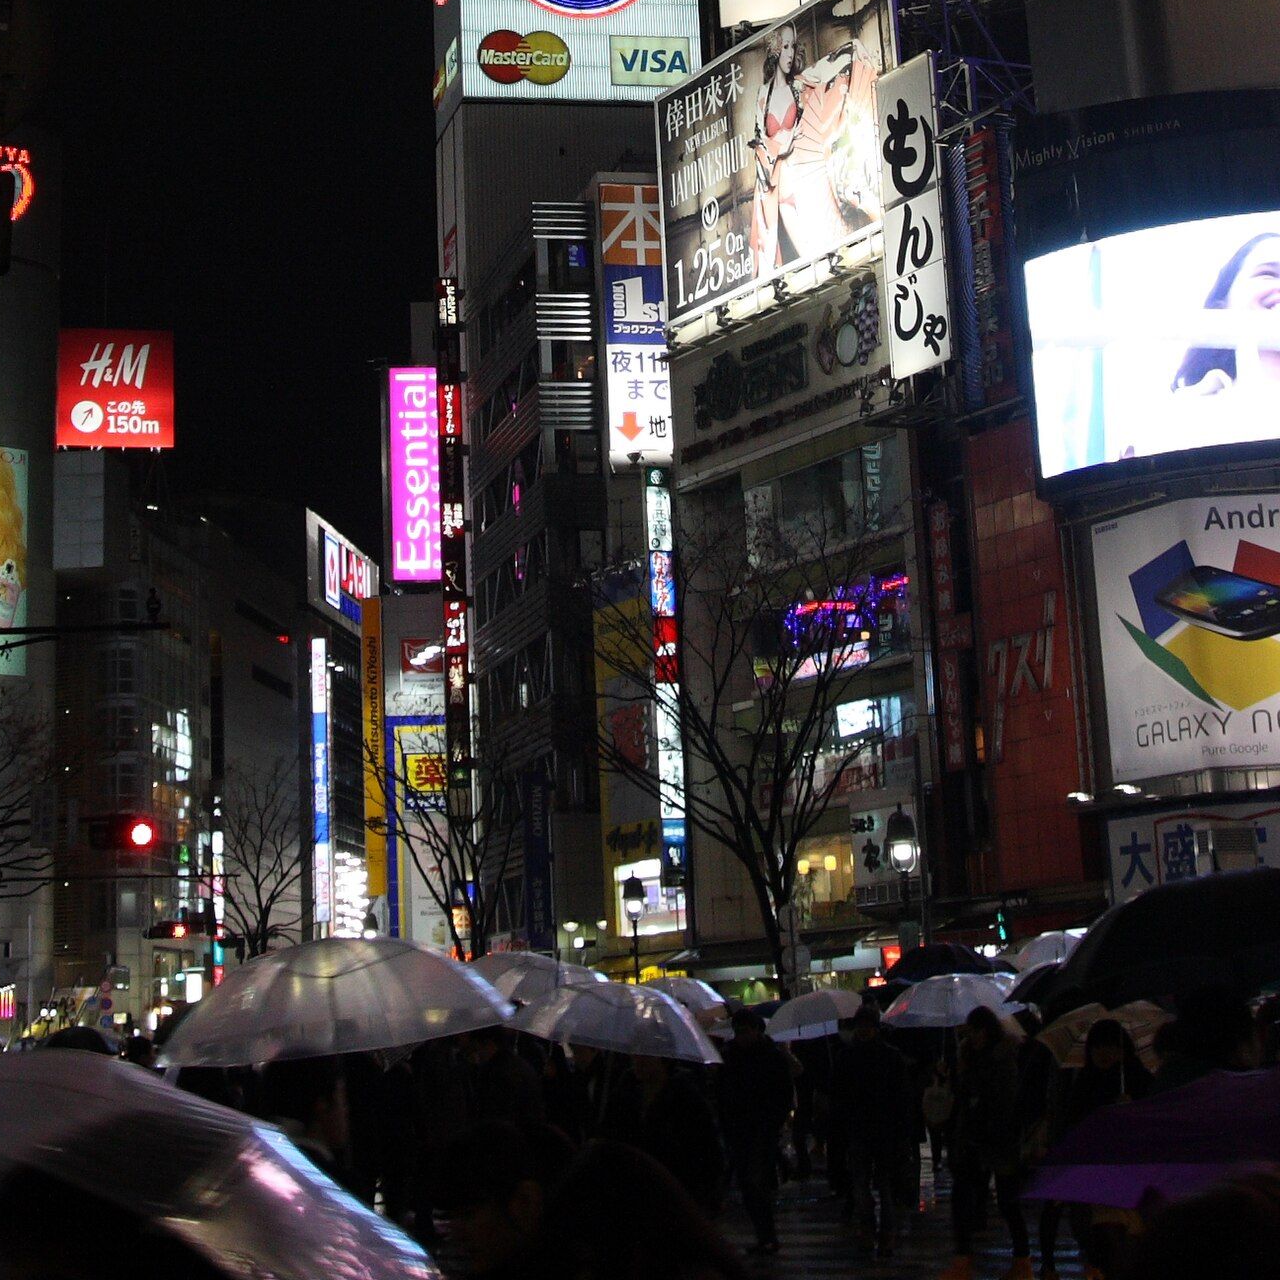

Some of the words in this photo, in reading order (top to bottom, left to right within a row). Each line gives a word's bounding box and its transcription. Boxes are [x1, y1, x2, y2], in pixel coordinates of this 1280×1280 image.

[479, 48, 569, 67] MasterCard
[619, 48, 689, 74] VISA
[1066, 129, 1116, 160] Vision
[1123, 119, 1182, 138] SHIBUYA
[670, 130, 749, 209] JAPONESQUE
[725, 231, 744, 257] On
[882, 98, 949, 357] もんじゃ
[673, 238, 725, 310] 1.25
[80, 342, 151, 390] H&M
[106, 399, 147, 416] この先
[106, 416, 160, 435] 150m
[394, 372, 431, 577] Essential
[1136, 710, 1233, 748] GALAXY
[1201, 743, 1226, 757] Pure
[1228, 741, 1269, 755] Google
